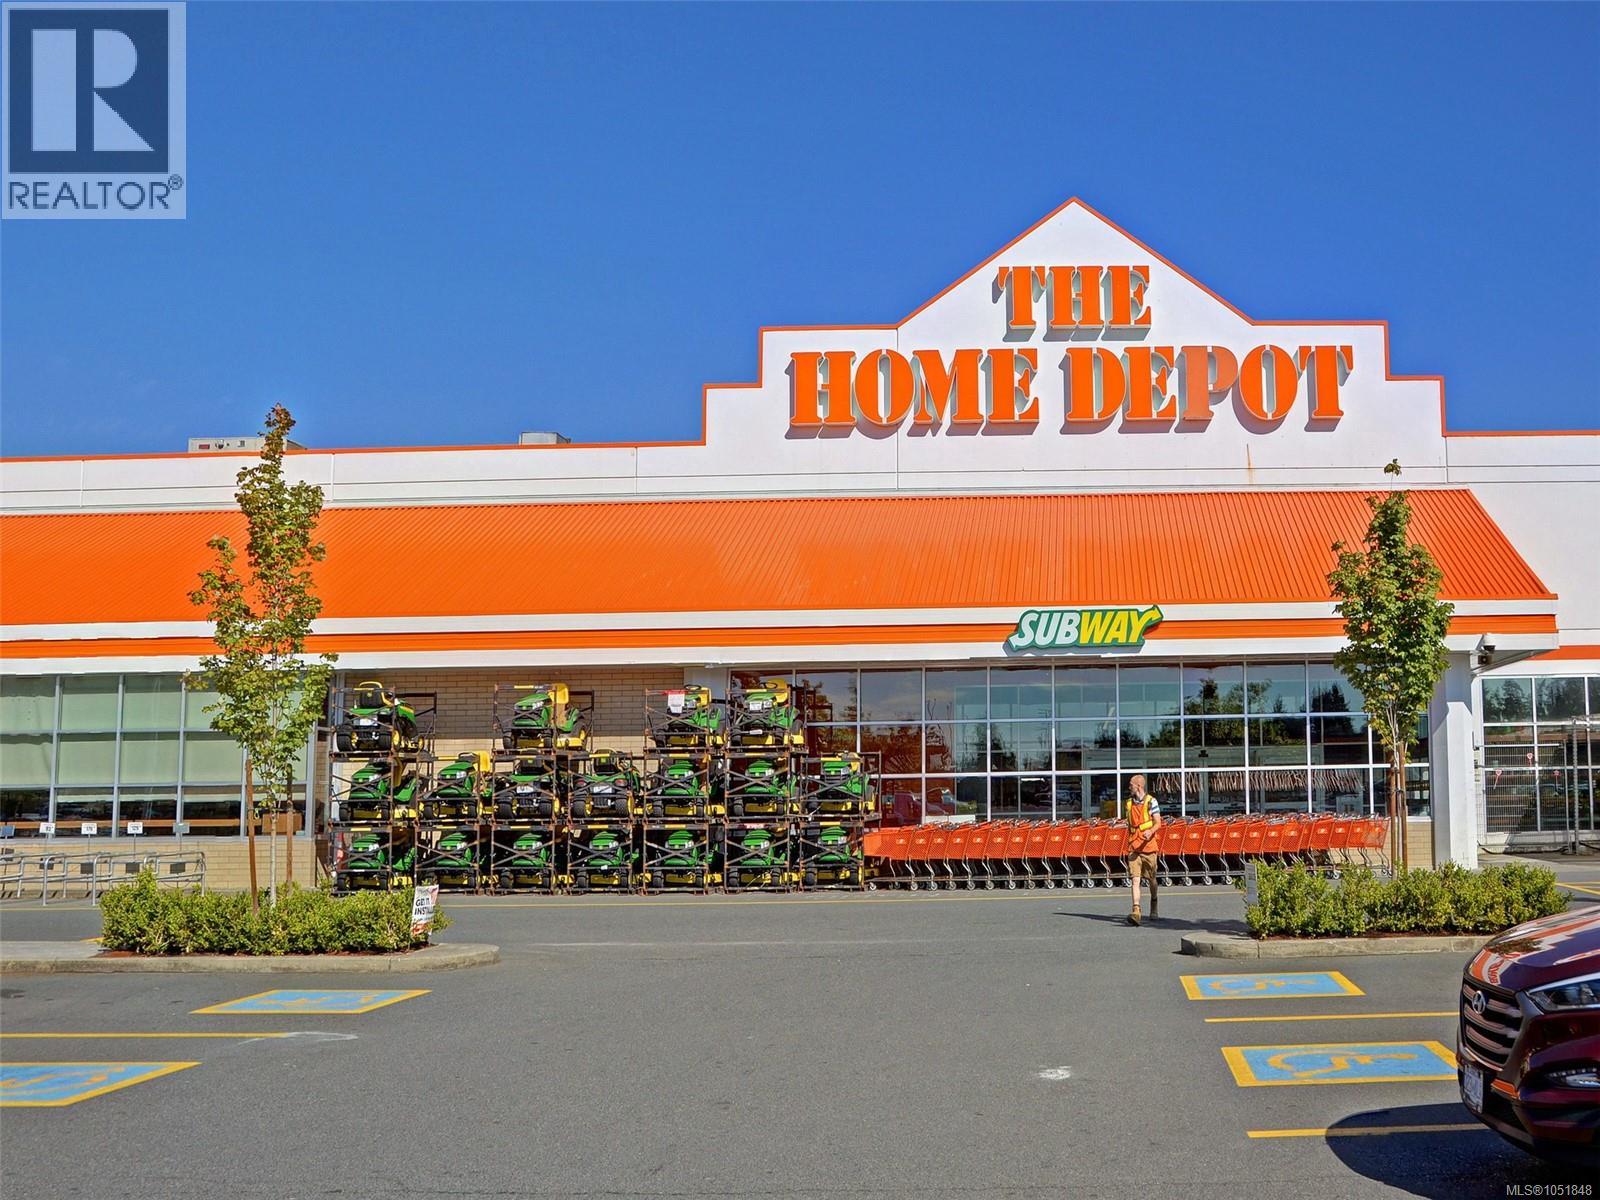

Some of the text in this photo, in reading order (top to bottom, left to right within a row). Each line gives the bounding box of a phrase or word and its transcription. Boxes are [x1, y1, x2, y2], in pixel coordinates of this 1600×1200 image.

[997, 264, 1152, 331] THE
[789, 344, 1355, 427] HOME DEPOT
[1008, 605, 1163, 649] SUBWAY
